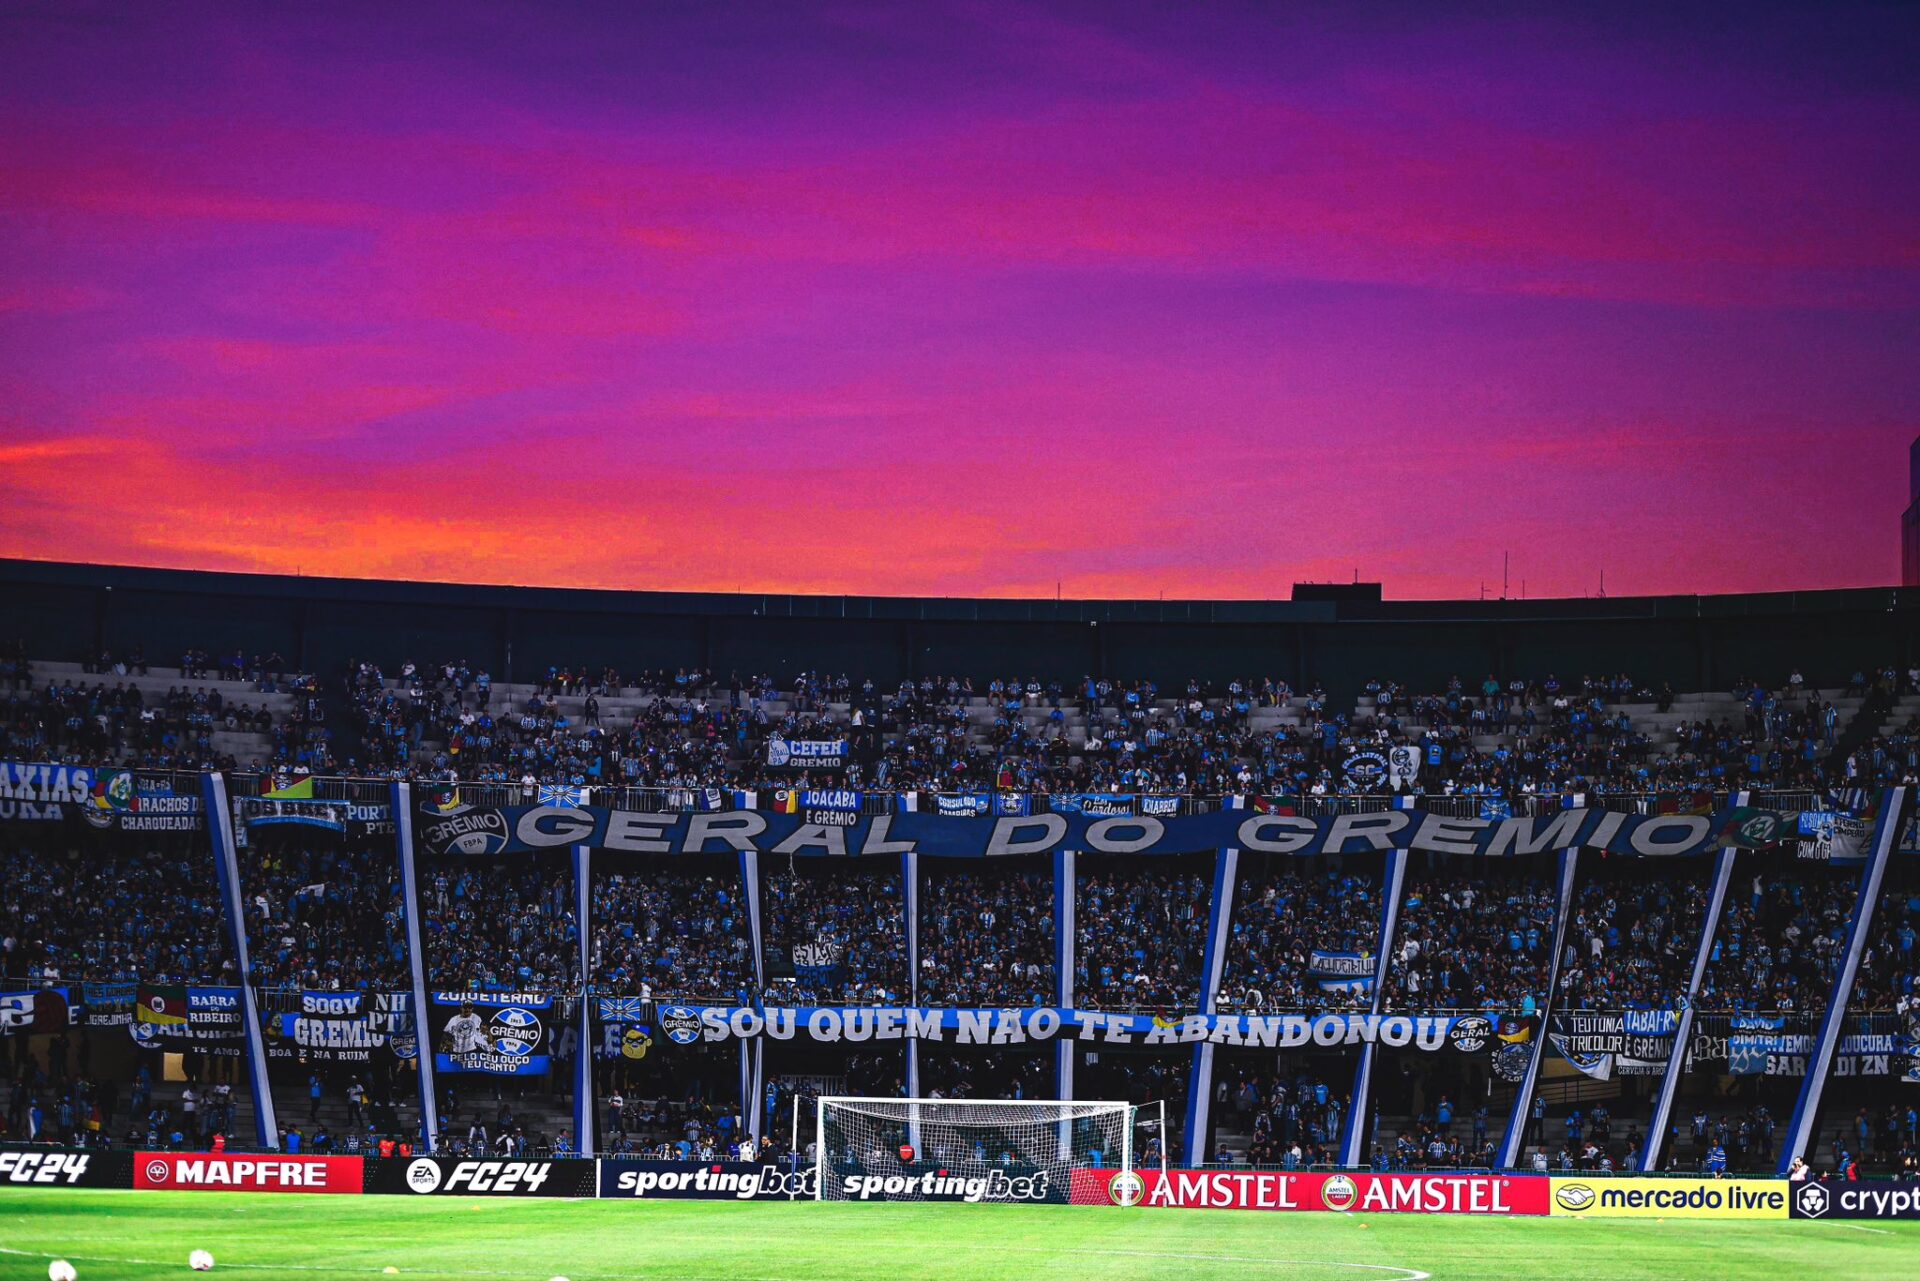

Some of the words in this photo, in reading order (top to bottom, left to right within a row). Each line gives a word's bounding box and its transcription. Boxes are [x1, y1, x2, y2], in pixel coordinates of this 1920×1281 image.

[791, 741, 841, 755] CEFER
[806, 790, 857, 808] JOAÇABA
[516, 806, 917, 856] GERAL
[985, 813, 1165, 856] DO
[190, 995, 237, 1006] BARRA
[374, 993, 407, 1012] NH
[189, 1012, 242, 1024] RIBEIRO
[490, 1025, 539, 1040] GRÊMIO
[701, 1007, 796, 1042] SOU
[808, 1008, 944, 1043] QUEM
[955, 1007, 1061, 1045] NÃO
[1073, 1013, 1134, 1043] TE
[1143, 1014, 1450, 1051] ABANDONOU
[1450, 1027, 1490, 1039] GERAL
[1570, 1035, 1622, 1051] TRICOLOR
[269, 1049, 292, 1057] BOA
[313, 1050, 331, 1060] NA
[338, 1051, 369, 1061] RUIM
[461, 1061, 481, 1069] TEU
[483, 1062, 516, 1072] CANTO
[176, 1160, 327, 1187] MAPFRE
[413, 1166, 434, 1177] EA
[444, 1162, 552, 1192] FC24
[617, 1165, 817, 1199] sportingbet
[843, 1169, 1049, 1202] sportingbet
[1601, 1185, 1722, 1209] mercado
[1728, 1186, 1784, 1209] livre
